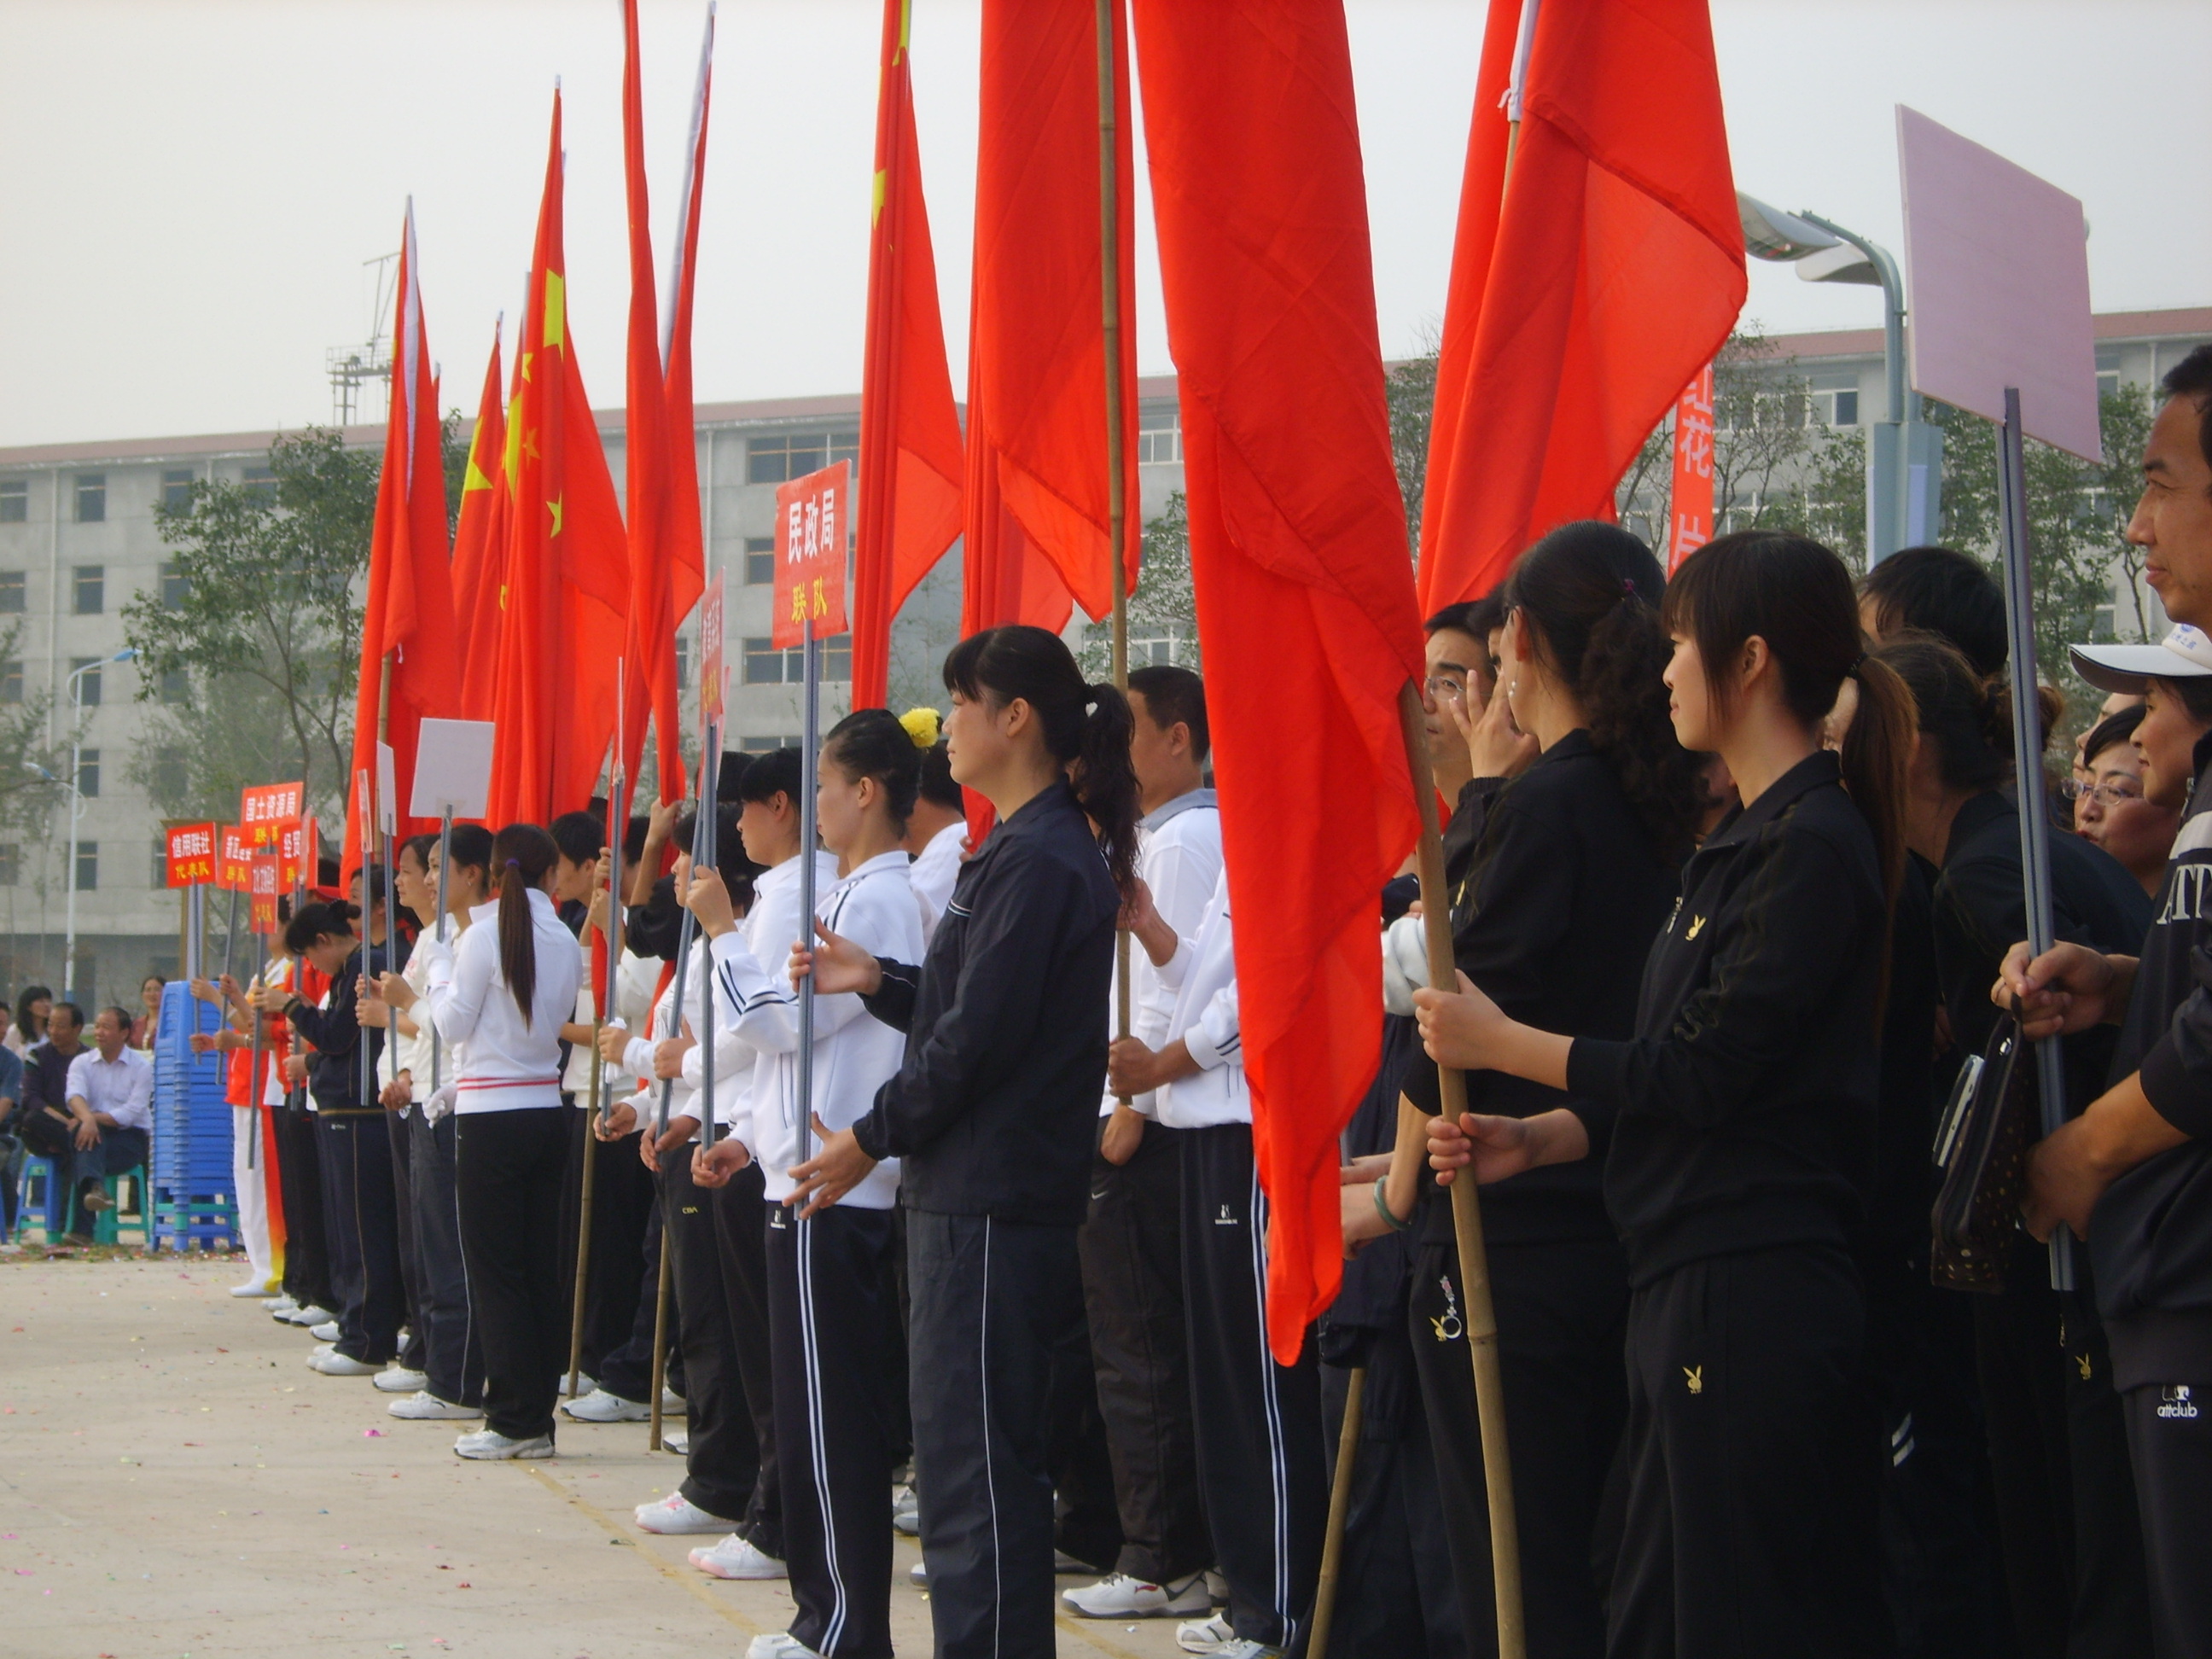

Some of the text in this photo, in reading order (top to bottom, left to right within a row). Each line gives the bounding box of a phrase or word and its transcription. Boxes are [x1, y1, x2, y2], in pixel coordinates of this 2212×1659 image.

[788, 487, 835, 564] 民政局
[791, 575, 829, 625] 联队
[245, 791, 296, 822] 国土资源局
[172, 830, 211, 859] 信用联社
[174, 860, 211, 880] 代表队
[2157, 1401, 2198, 1418] attclub
